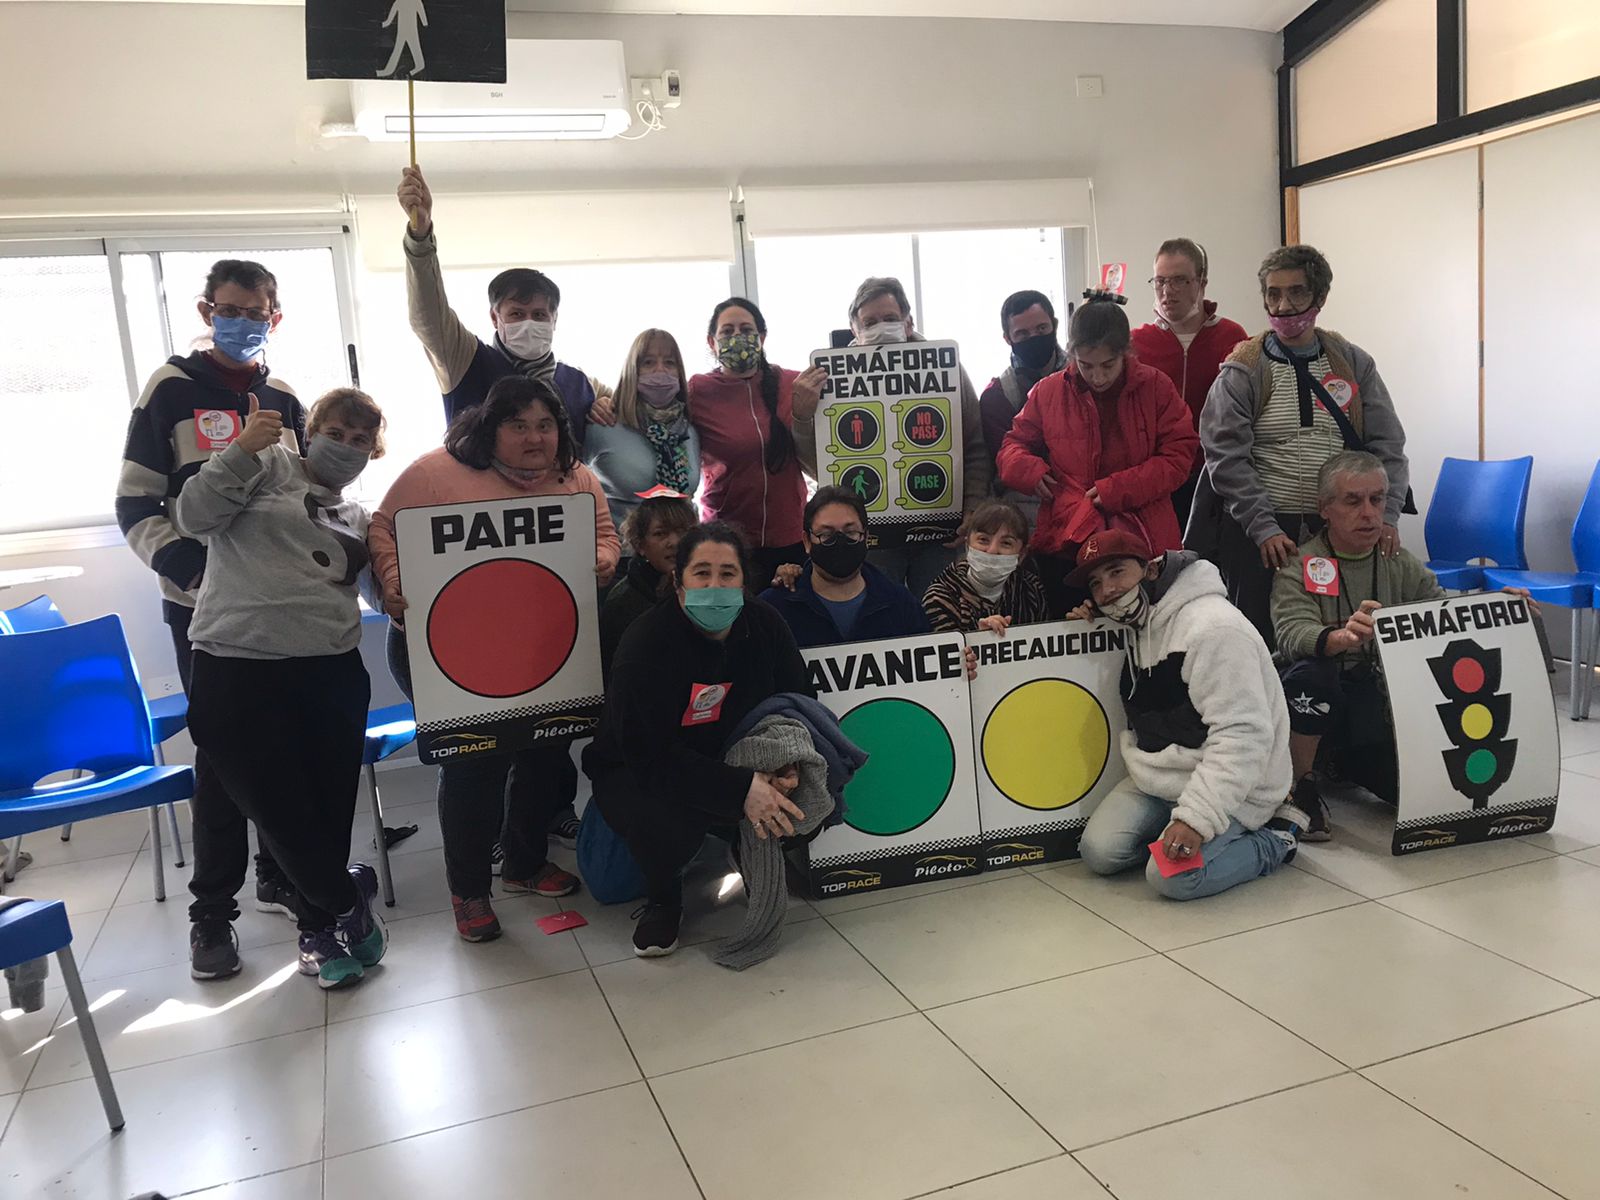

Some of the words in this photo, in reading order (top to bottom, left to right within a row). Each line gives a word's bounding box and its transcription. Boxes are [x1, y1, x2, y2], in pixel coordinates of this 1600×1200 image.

[814, 346, 957, 376] SEMÁFORO
[820, 371, 957, 400] PEATONAL
[911, 425, 938, 440] PASE
[916, 412, 932, 426] NO
[913, 475, 940, 490] PASE
[430, 505, 565, 555] PARE
[1376, 601, 1530, 644] SEMÁFORO
[809, 643, 962, 694] AVANCE
